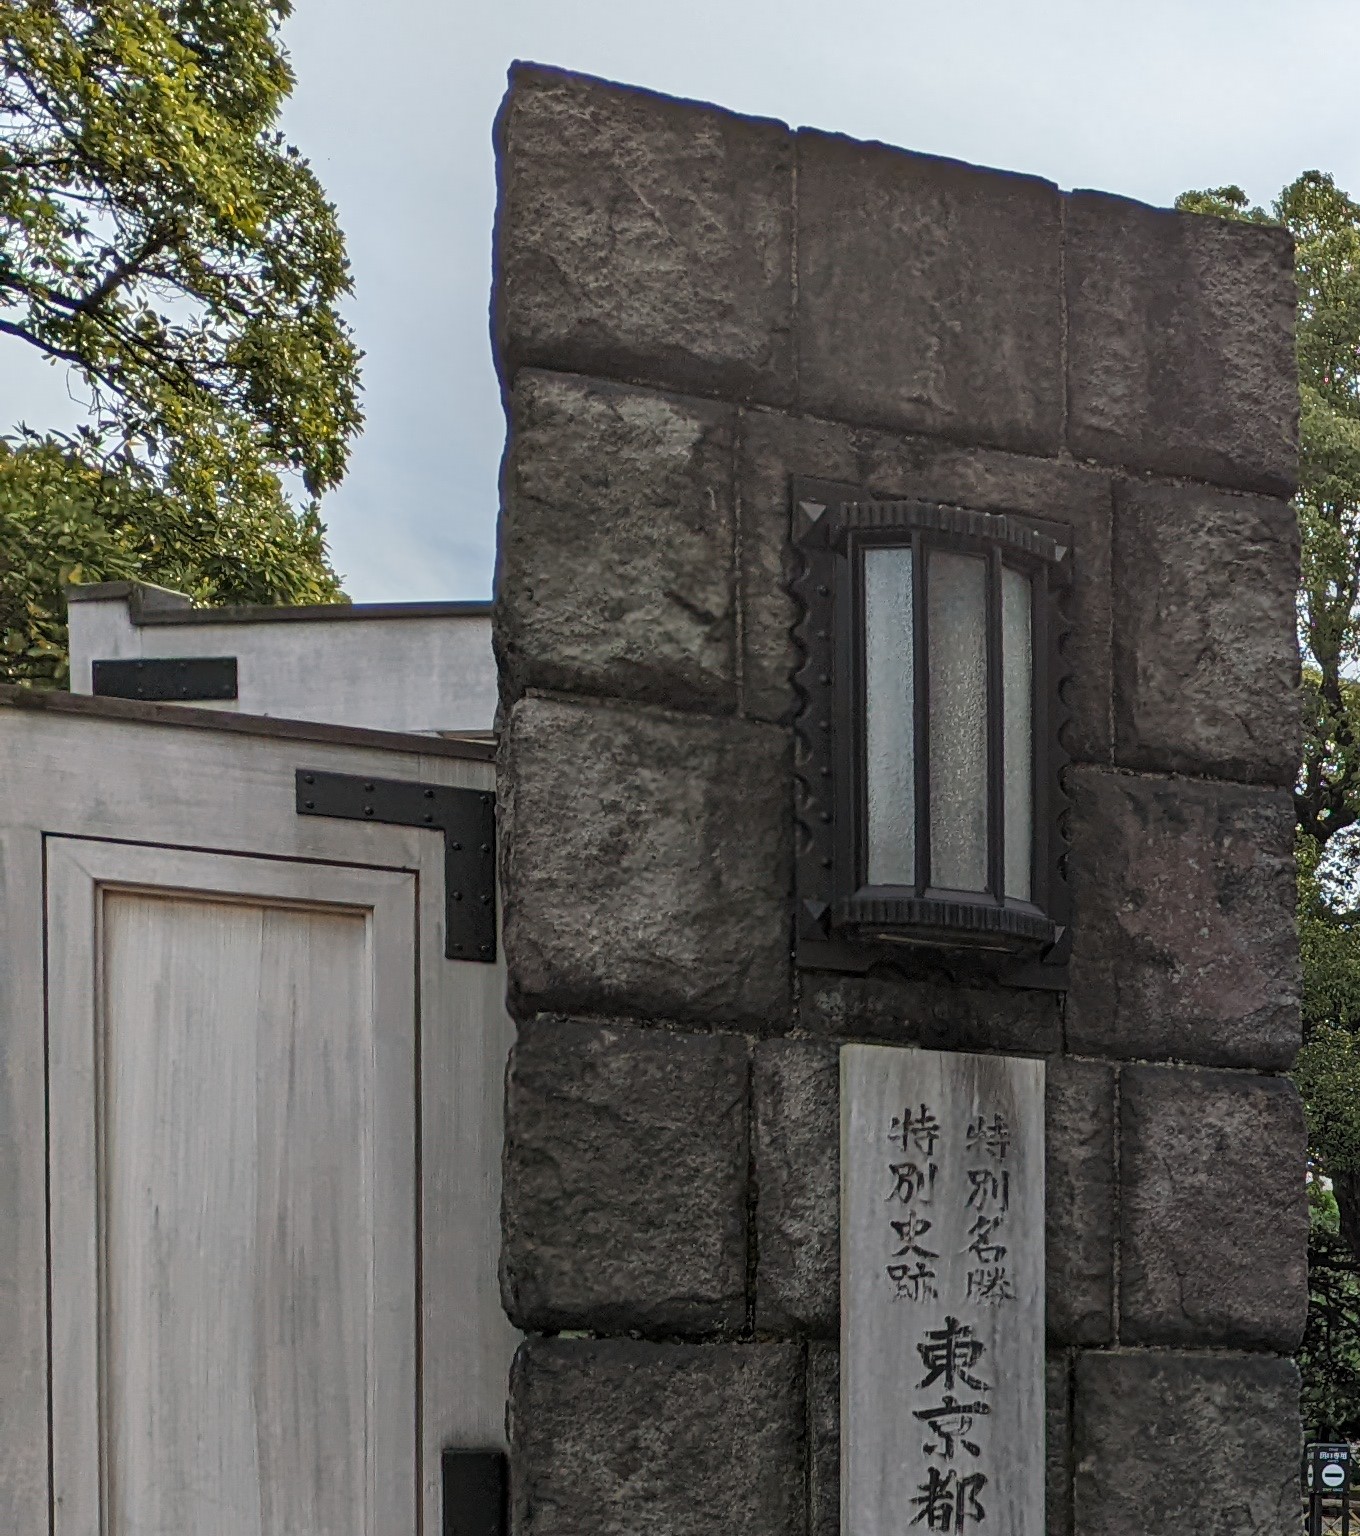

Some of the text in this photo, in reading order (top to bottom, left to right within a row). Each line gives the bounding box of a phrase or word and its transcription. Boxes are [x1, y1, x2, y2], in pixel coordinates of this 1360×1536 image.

[885, 1103, 941, 1303] 特別史跡
[964, 1112, 1016, 1302] 特別名勝
